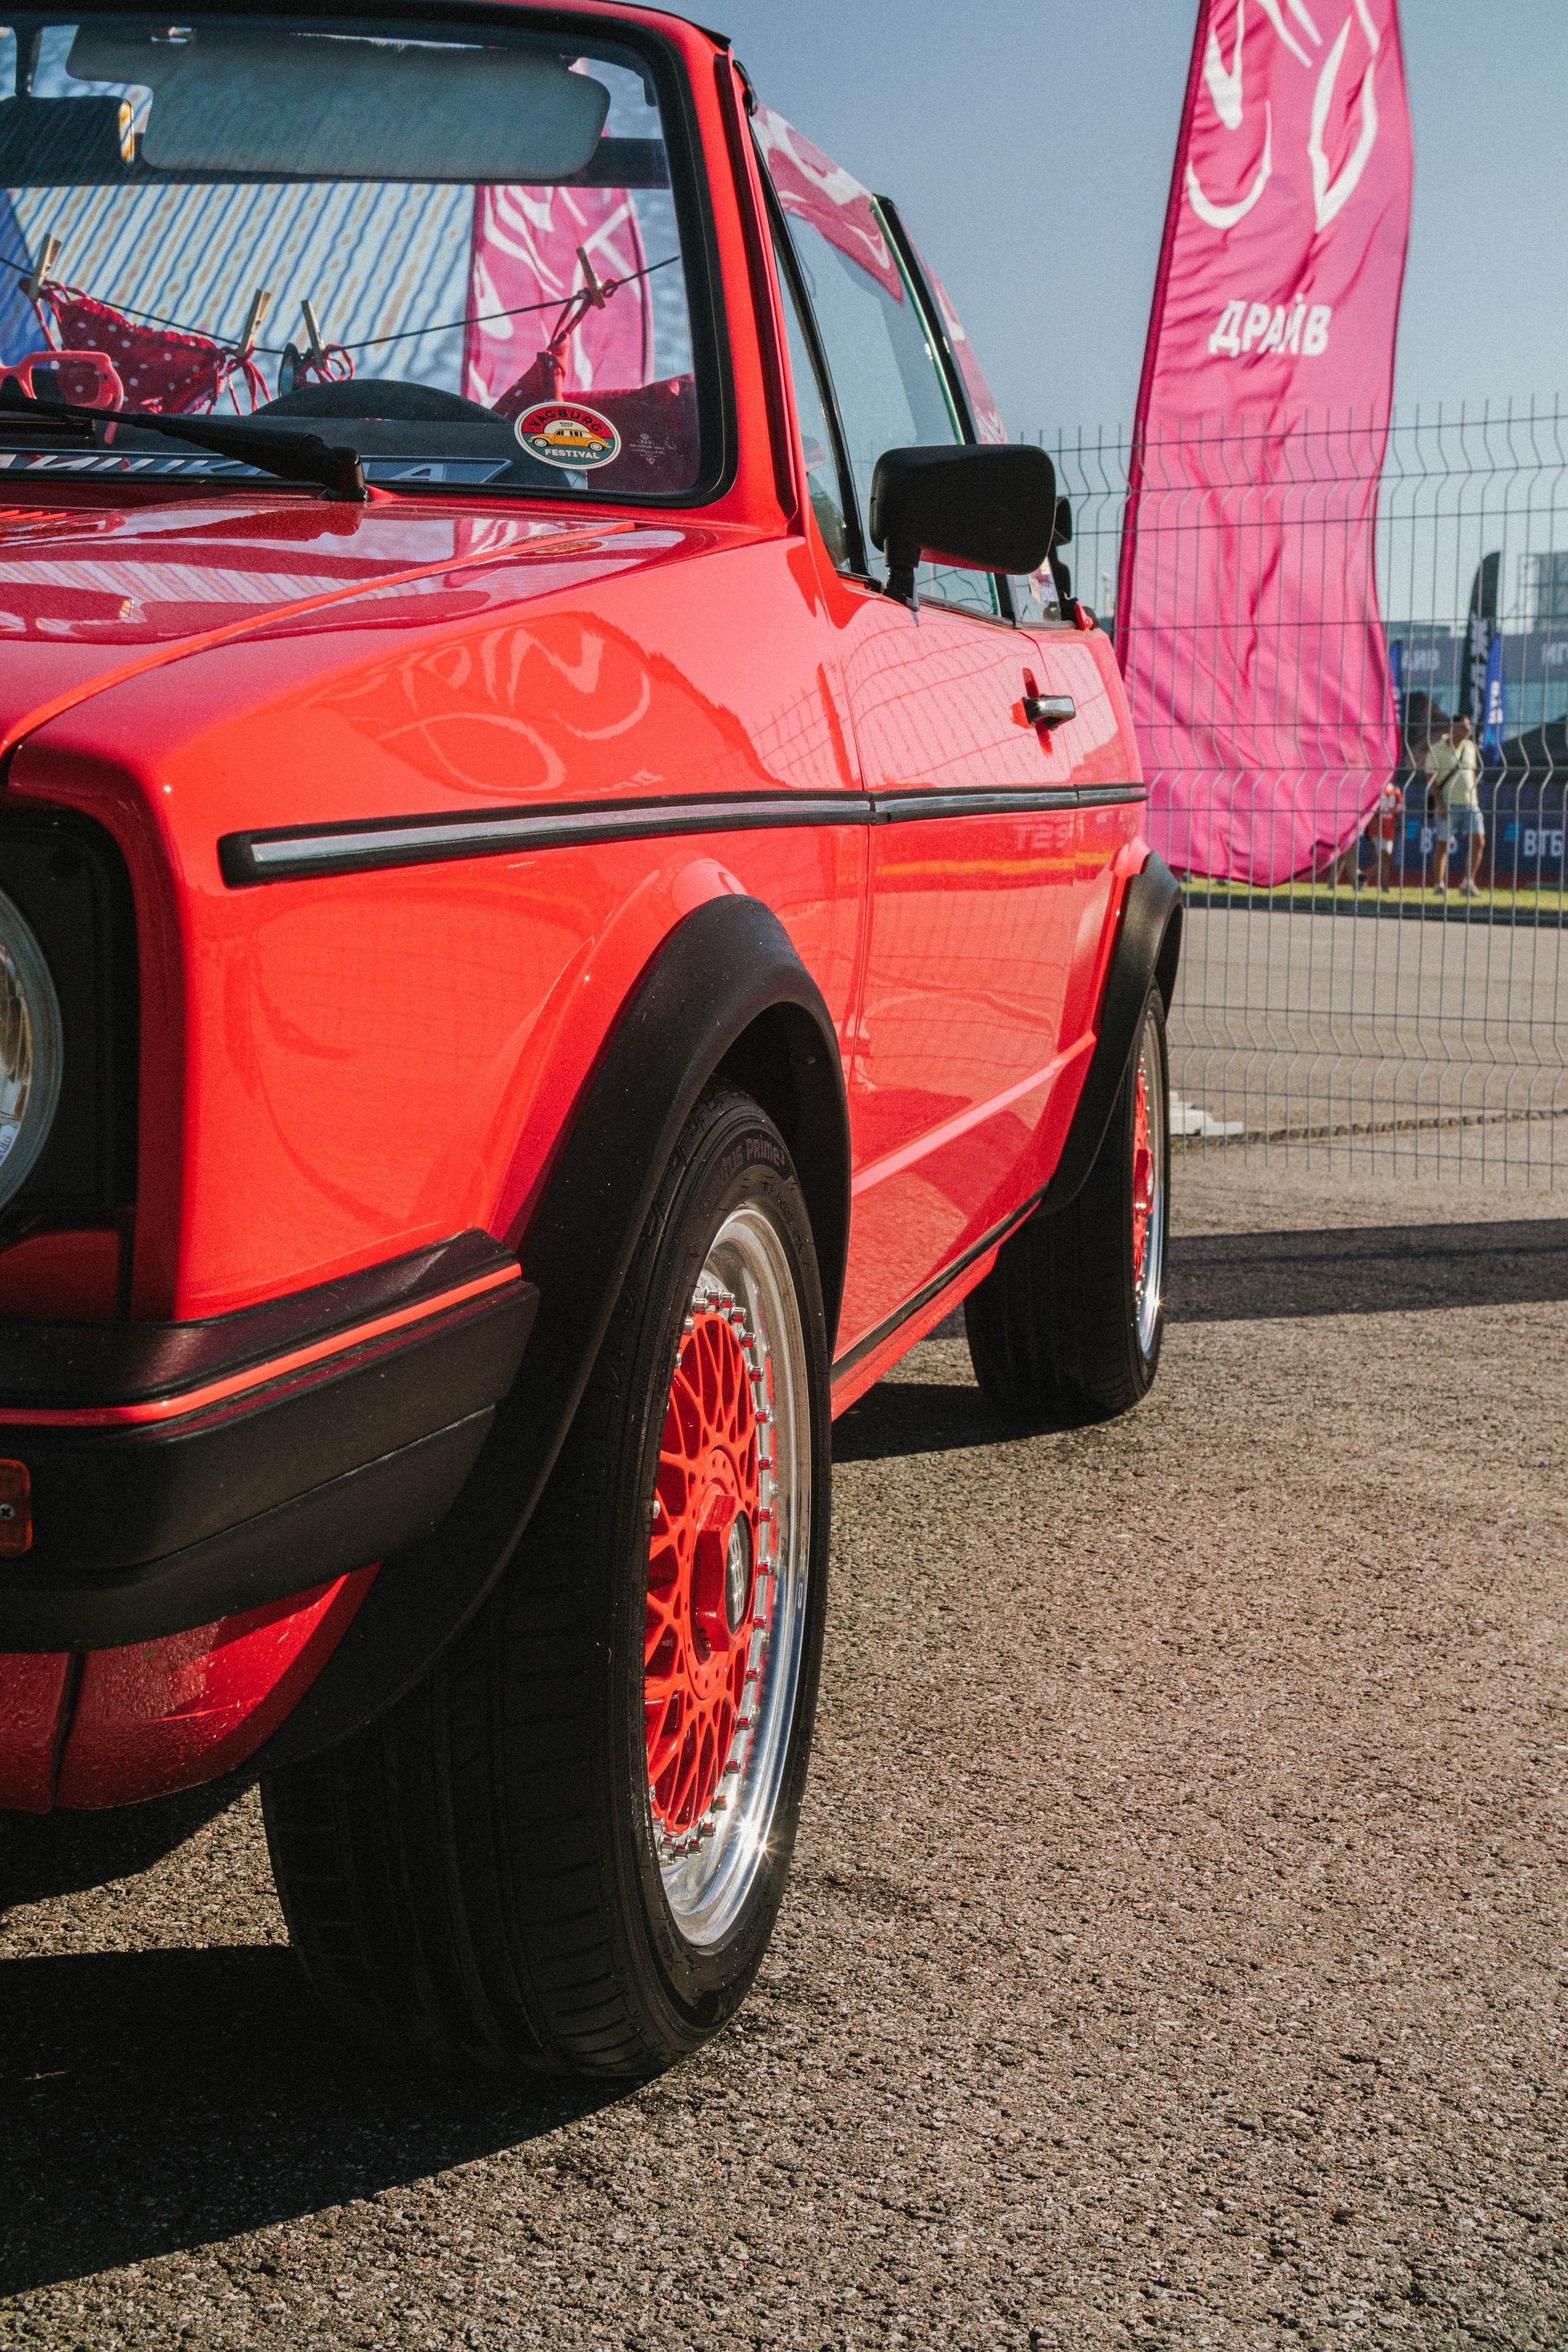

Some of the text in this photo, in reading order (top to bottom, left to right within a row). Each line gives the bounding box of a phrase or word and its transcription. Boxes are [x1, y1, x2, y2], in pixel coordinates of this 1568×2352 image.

[1208, 293, 1333, 358] ДРАЙВ
[528, 409, 603, 432] VAGBURG
[545, 448, 600, 459] FESTIVAL
[1523, 828, 1564, 857] ВТБ
